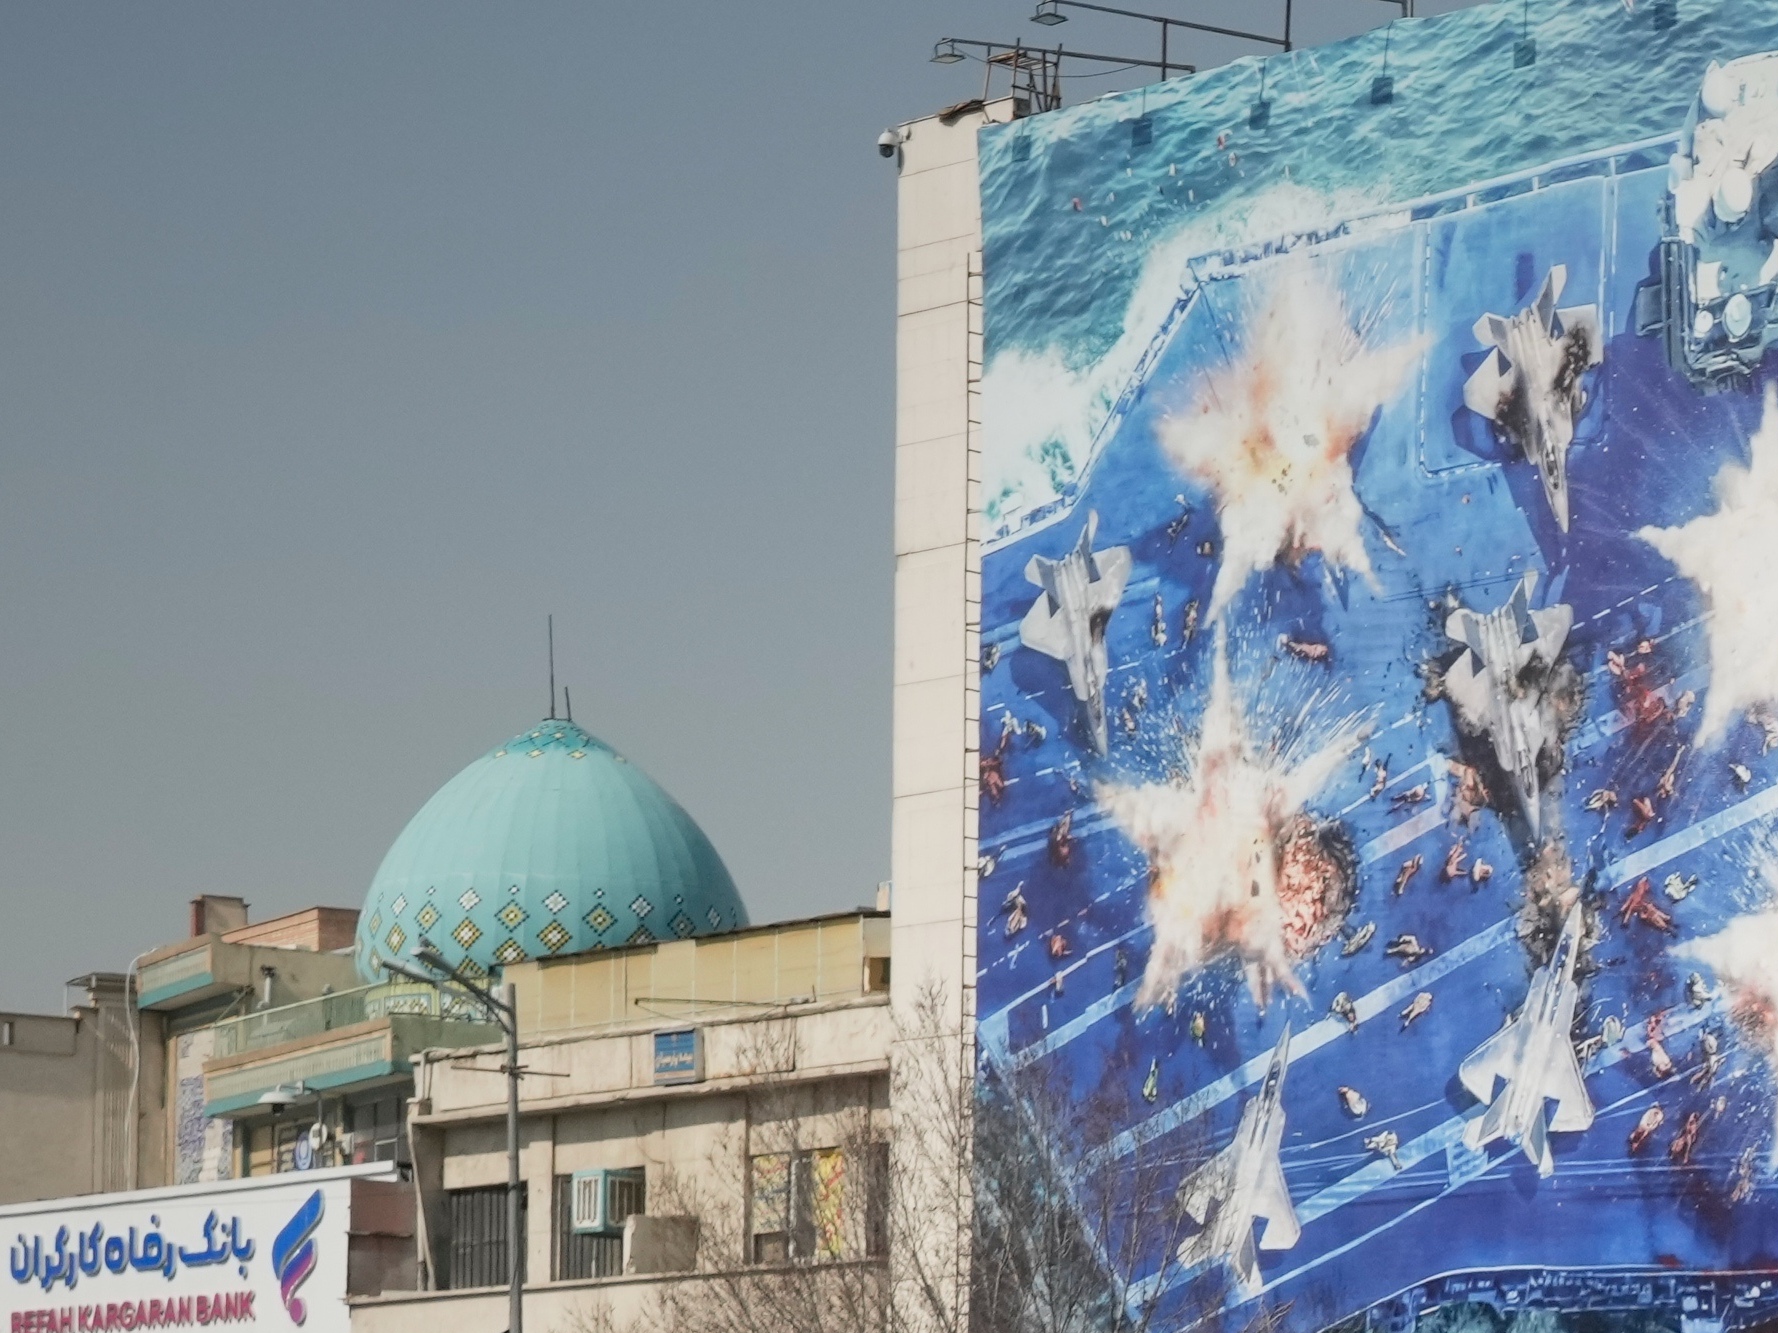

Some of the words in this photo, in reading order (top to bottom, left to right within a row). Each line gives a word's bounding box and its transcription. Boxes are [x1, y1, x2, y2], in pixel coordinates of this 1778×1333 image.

[10, 1220, 105, 1293] کارگران
[104, 1213, 177, 1282] رفاه
[179, 1208, 255, 1280] بانک
[196, 1289, 257, 1327] BANK
